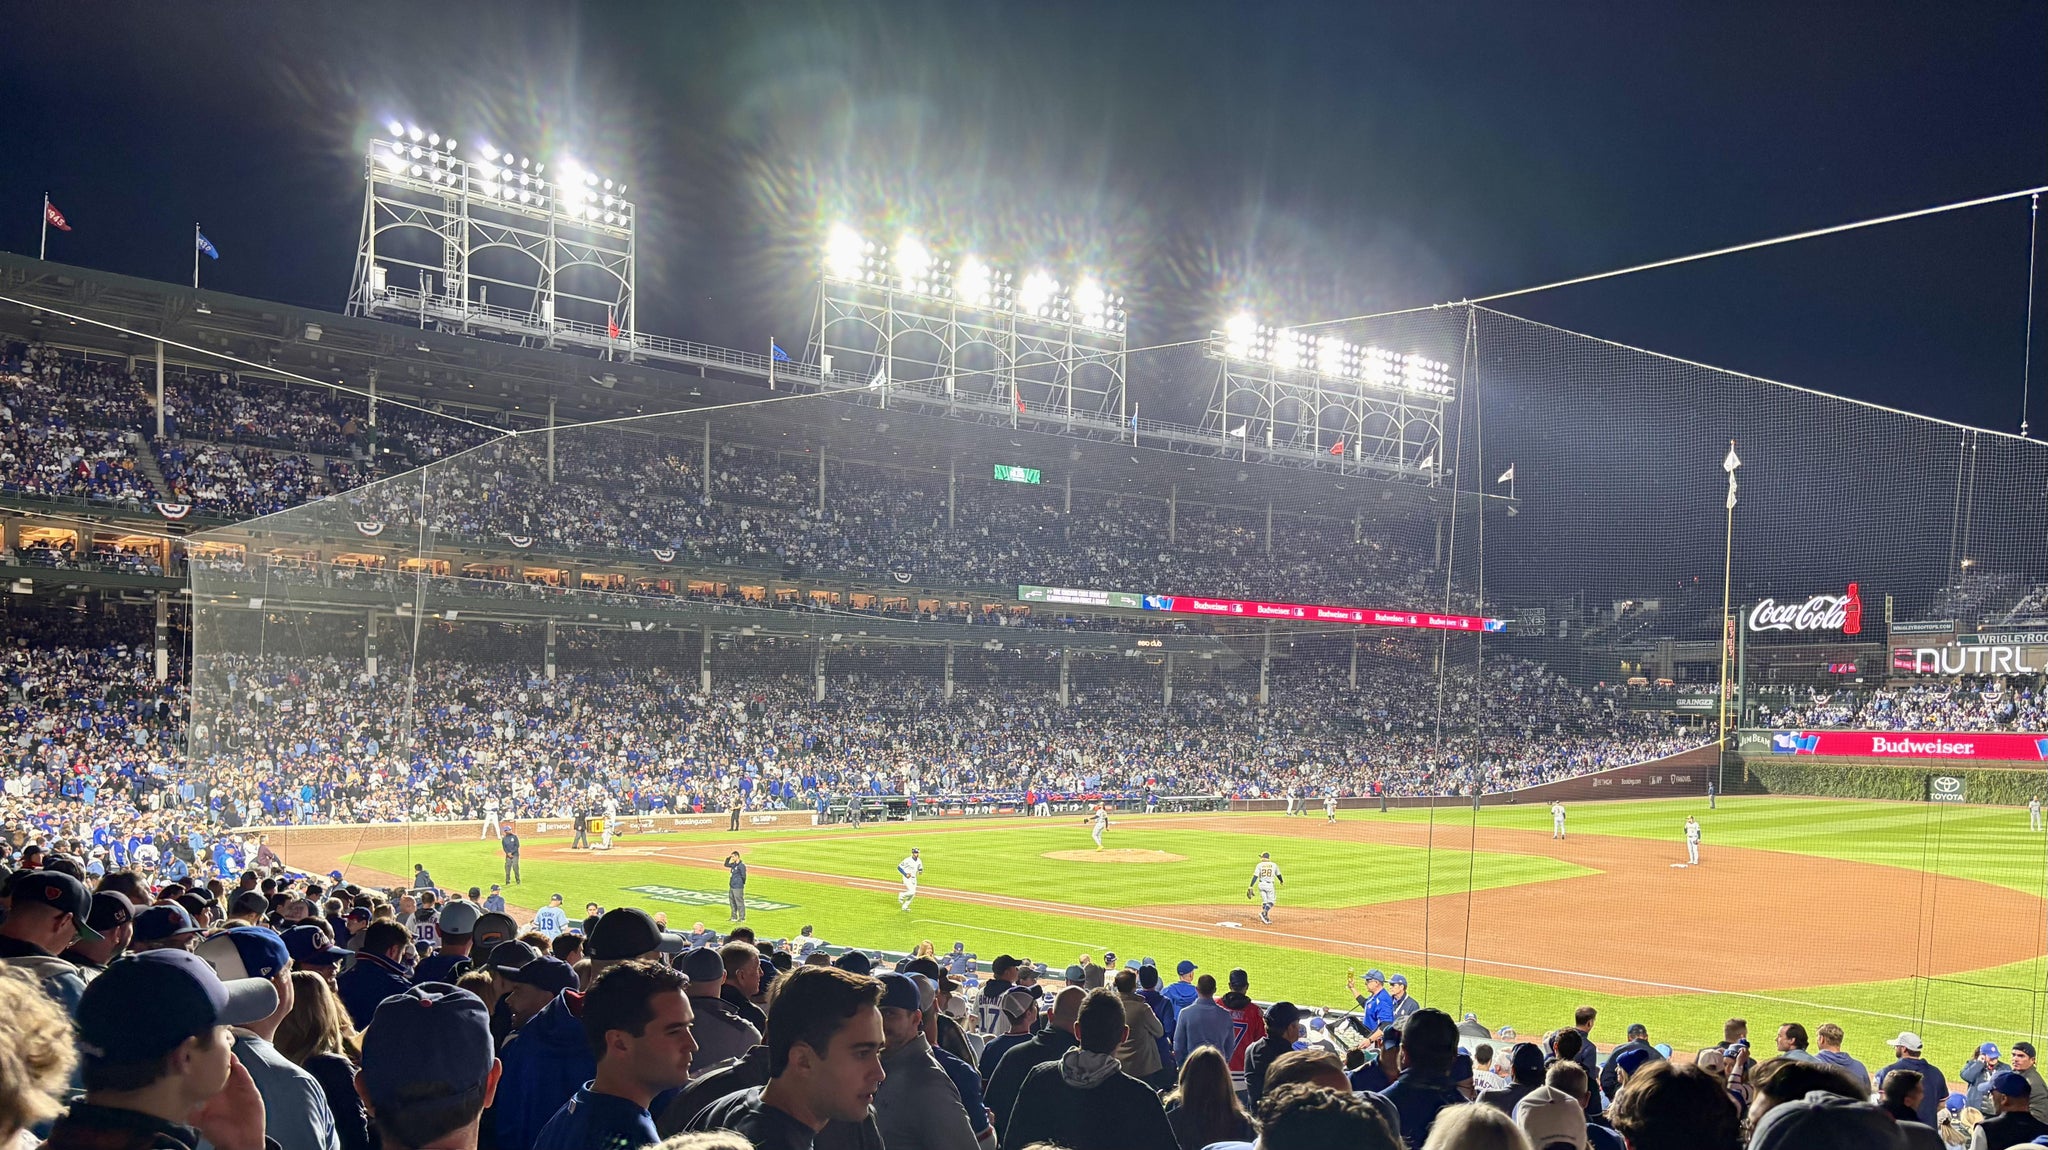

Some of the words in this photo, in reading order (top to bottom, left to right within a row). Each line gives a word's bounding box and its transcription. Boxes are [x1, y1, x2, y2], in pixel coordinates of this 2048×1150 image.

[1194, 601, 1228, 611] Budweiser
[1258, 605, 1290, 615] Budweiser
[1318, 609, 1349, 618] Budweiser
[1749, 595, 1852, 631] Coca-Cola
[1740, 736, 1753, 747] JIM
[1753, 733, 1770, 747] BEAM
[1872, 737, 1974, 754] Budweiser
[1930, 793, 1964, 801] TOYOTA
[674, 818, 713, 826] Booking.com
[1261, 868, 1272, 877] 28
[541, 918, 554, 930] 19
[416, 925, 434, 940] 18
[979, 1007, 1000, 1033] 17
